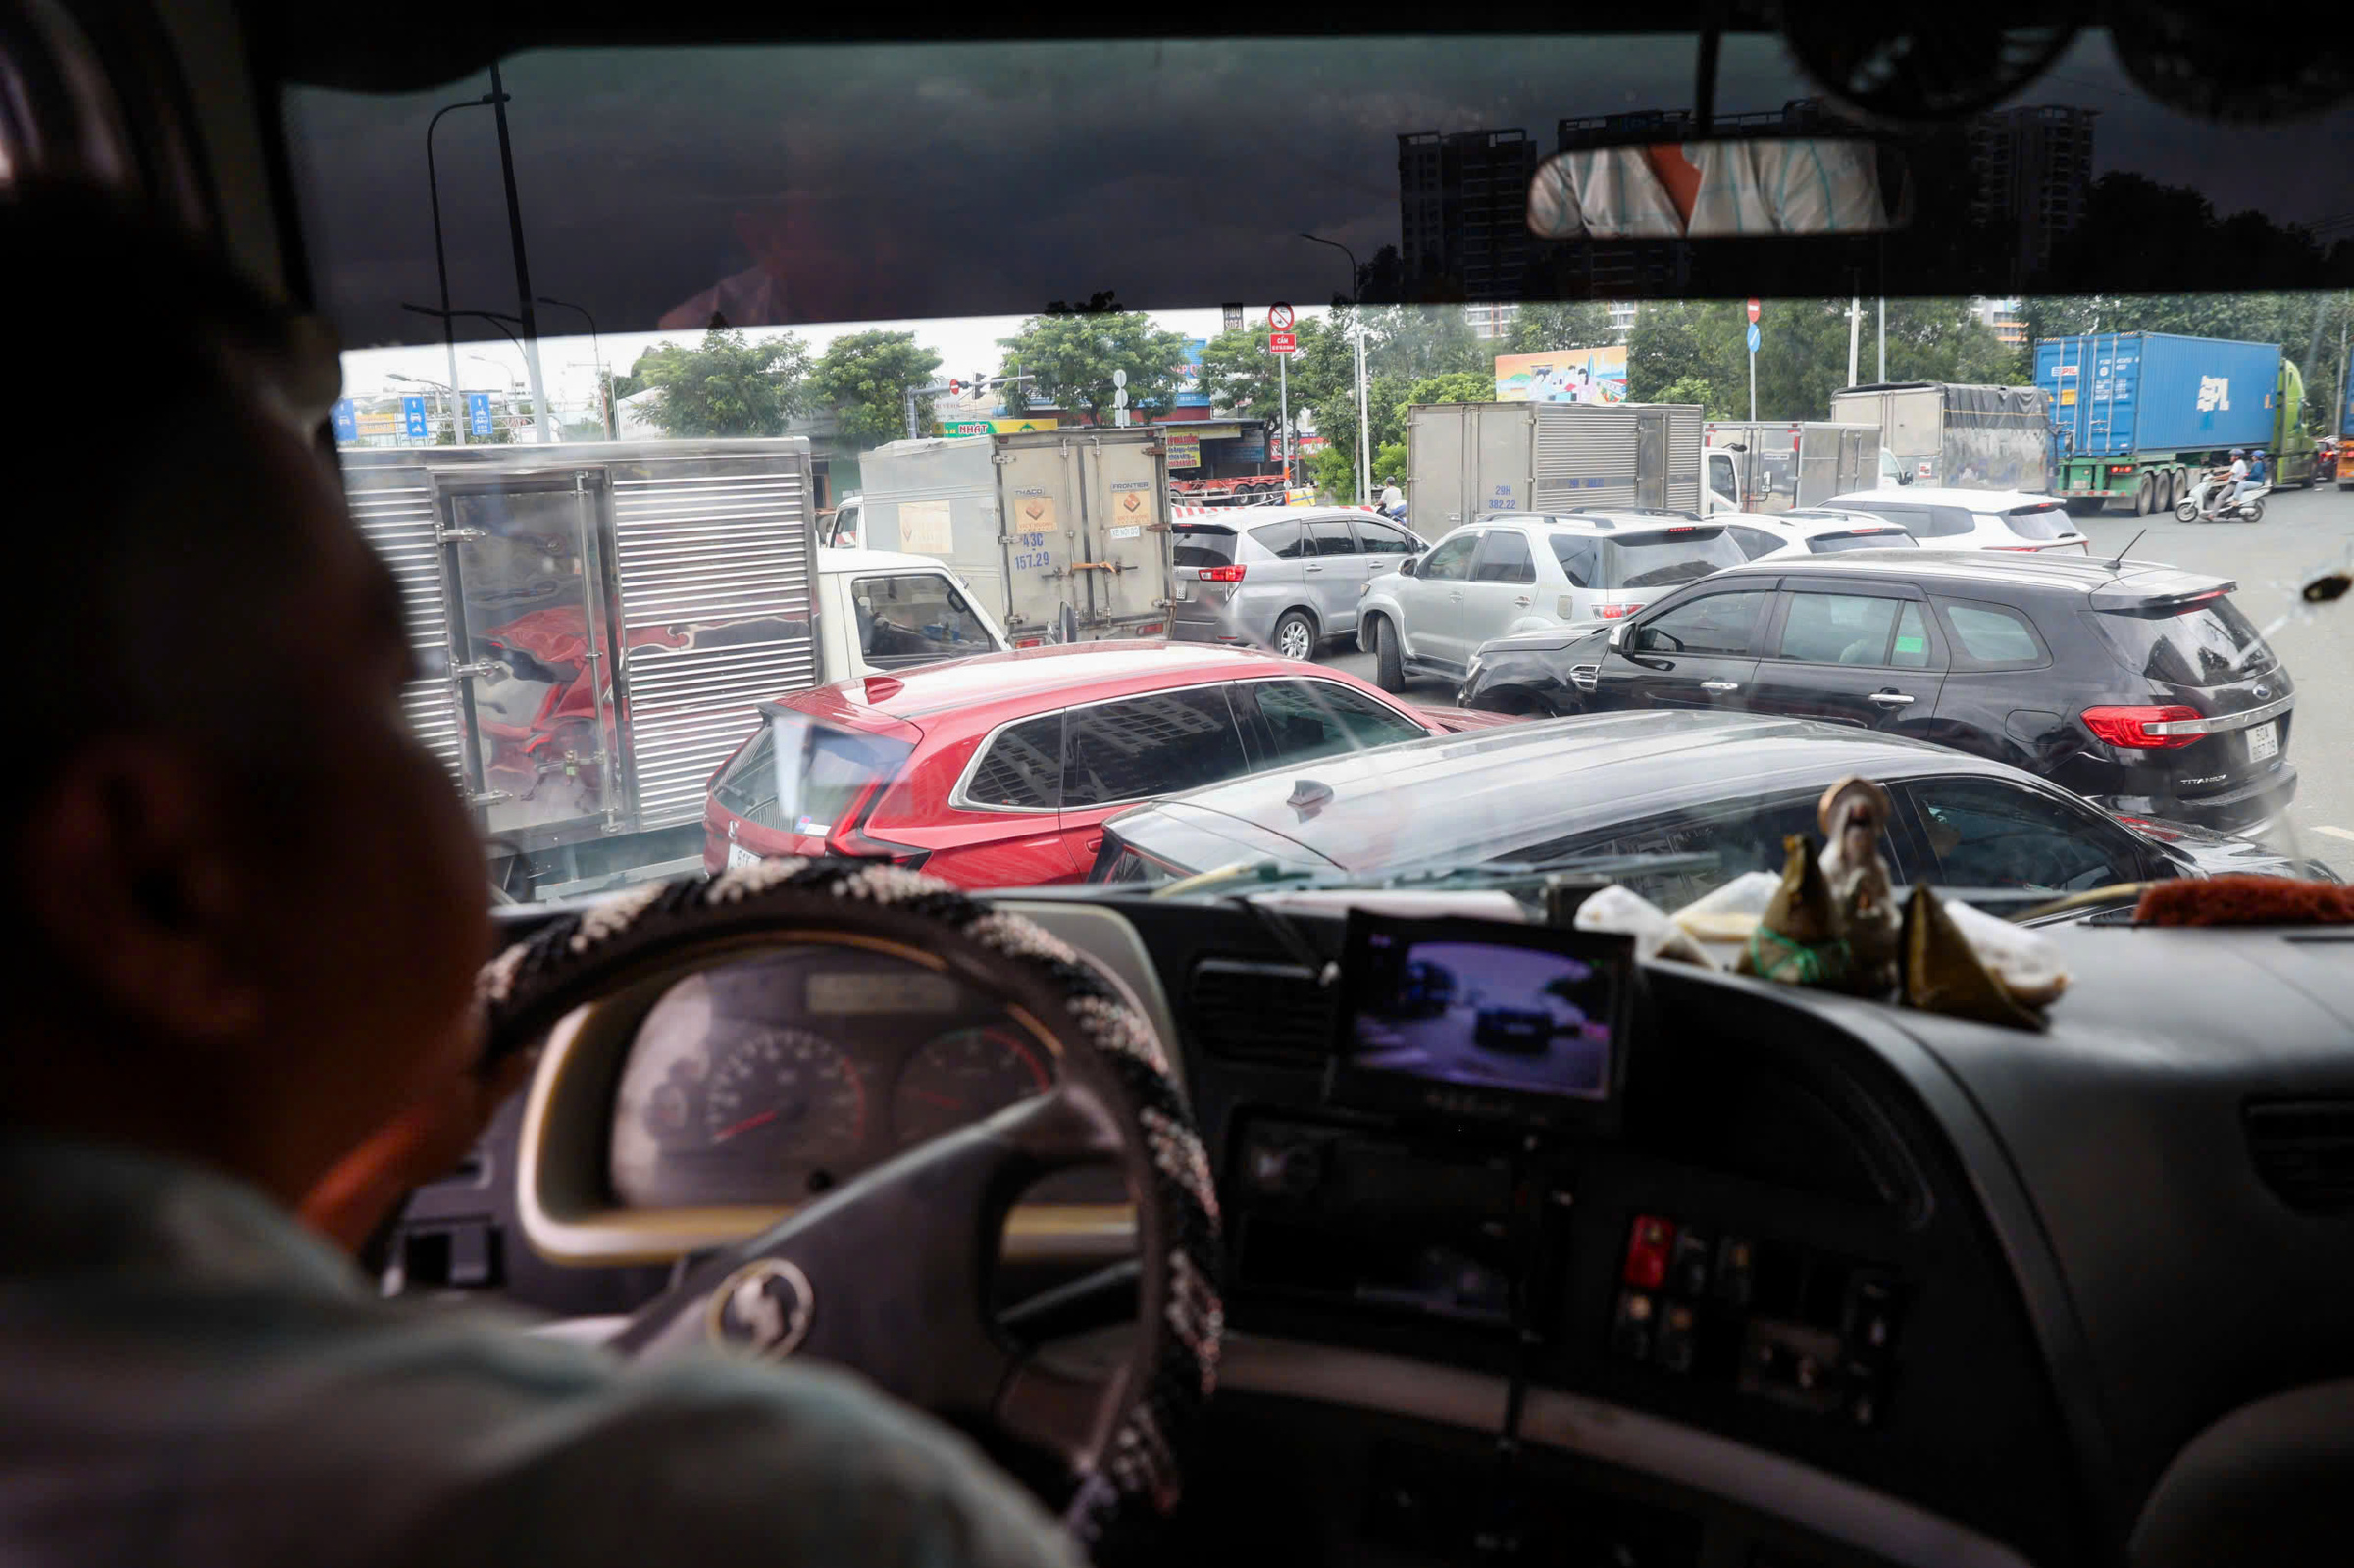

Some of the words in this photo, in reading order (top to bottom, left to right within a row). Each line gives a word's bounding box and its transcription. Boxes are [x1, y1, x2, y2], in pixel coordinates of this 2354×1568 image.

[1112, 481, 1149, 490] FRONTIER
[1496, 485, 1511, 496] 29H
[1489, 499, 1515, 510] 382.22
[1023, 532, 1044, 548] 43C
[1015, 551, 1050, 571] 157.29
